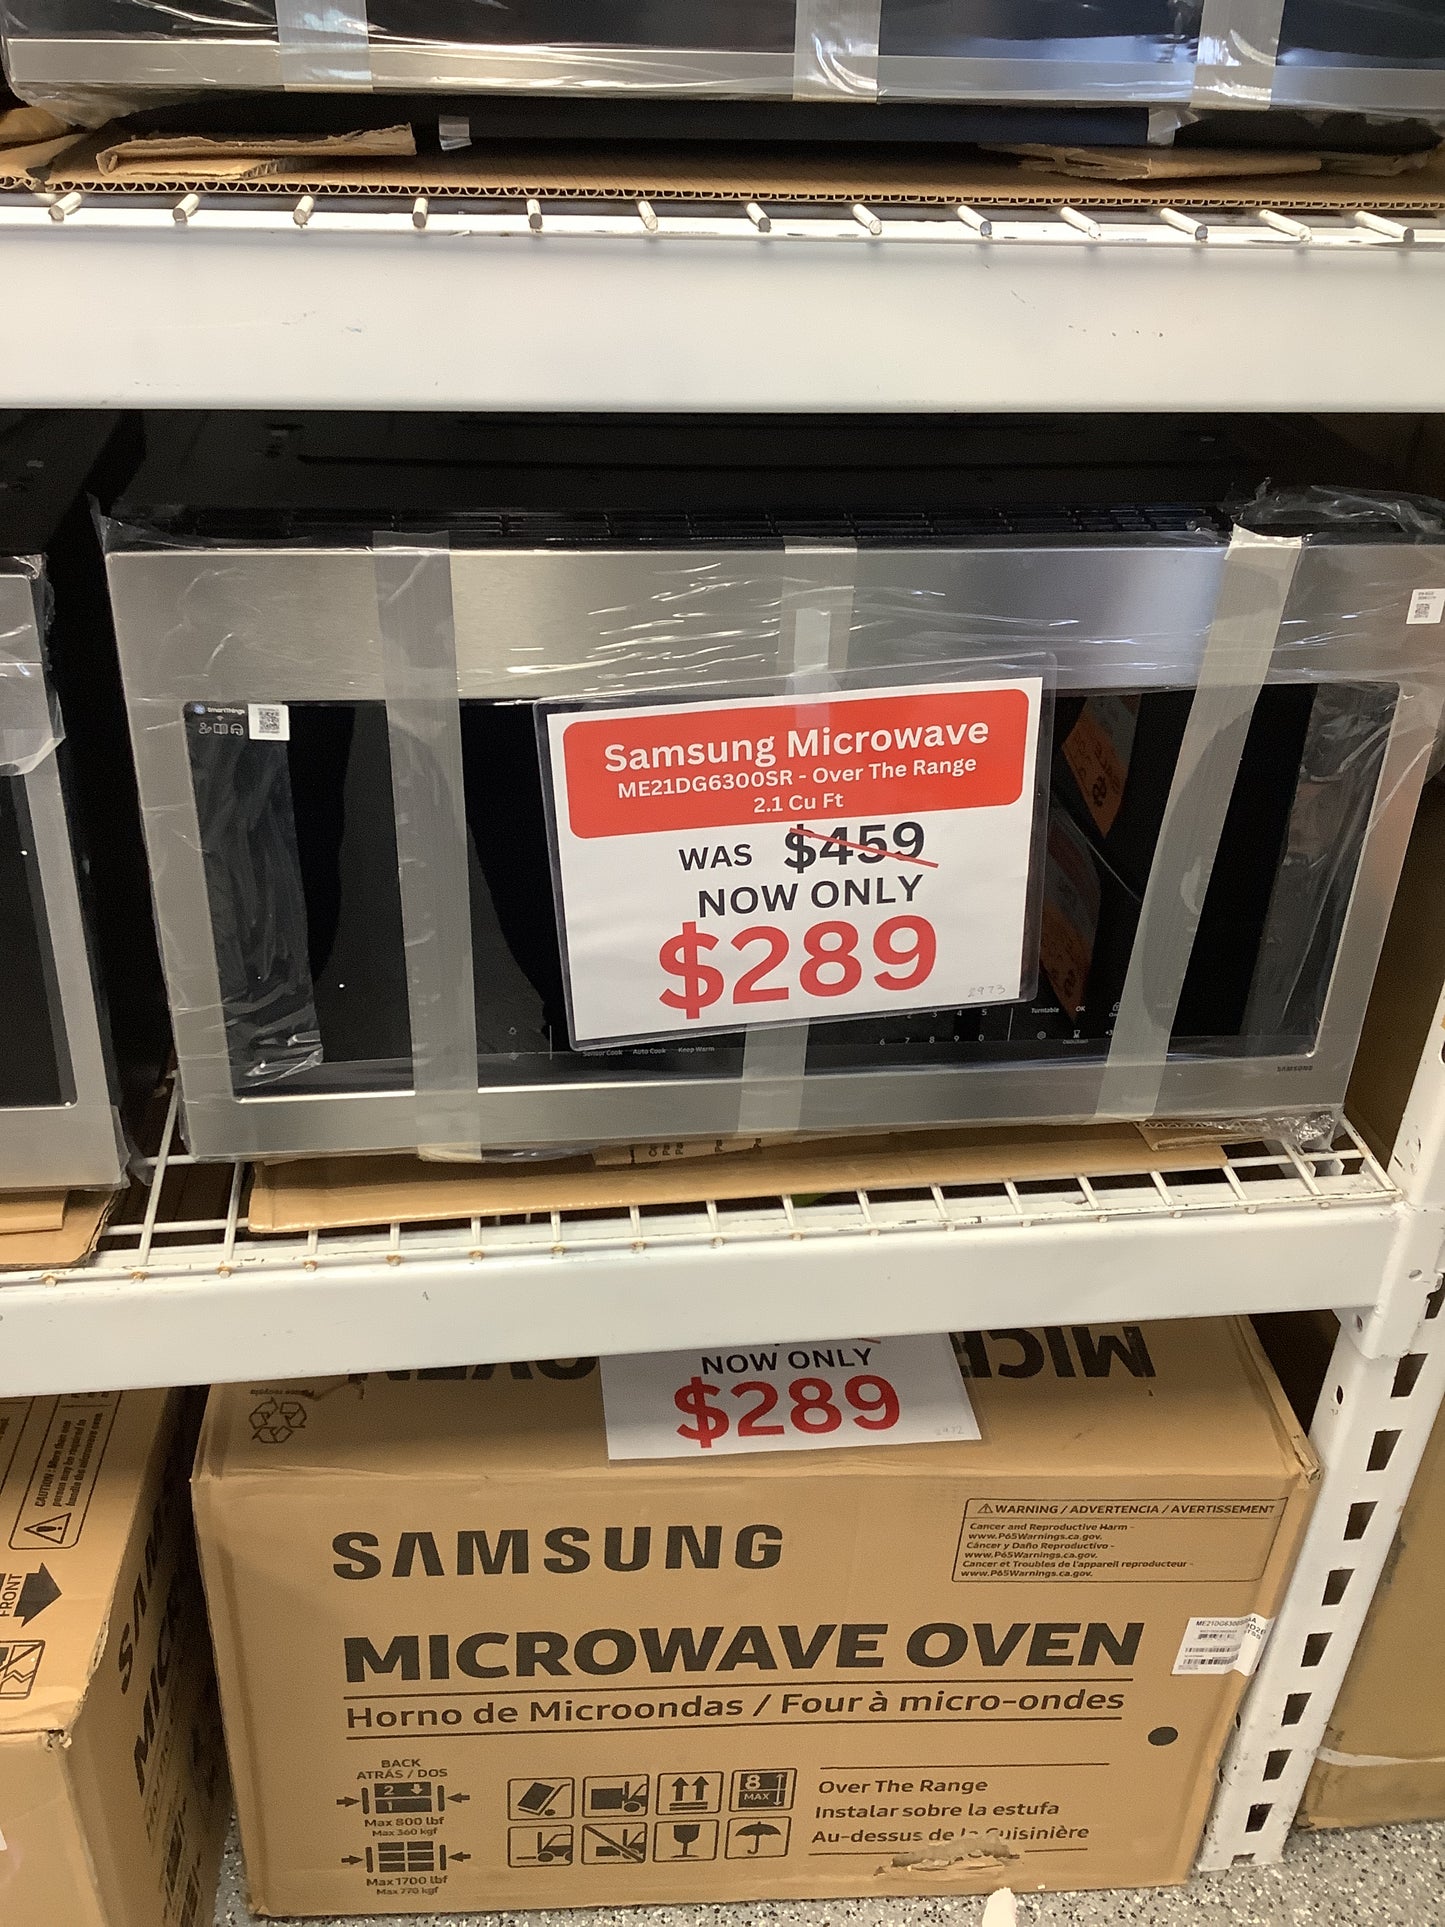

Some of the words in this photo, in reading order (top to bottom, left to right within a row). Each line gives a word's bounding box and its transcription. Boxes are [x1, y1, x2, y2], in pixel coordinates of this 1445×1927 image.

[604, 735, 777, 772] Samsung
[787, 721, 989, 758] Microwave
[618, 769, 793, 799] ME21DG6300SR
[813, 766, 864, 784] Over
[868, 762, 907, 780] The
[913, 758, 977, 777] Range
[753, 797, 783, 813] 2.1
[788, 795, 816, 811] Cu
[823, 793, 844, 808] Ft
[679, 844, 752, 871] WAS
[784, 821, 925, 874] $459
[699, 883, 799, 918] NOW
[811, 874, 923, 908] ONLY
[659, 914, 937, 1020] $289
[632, 1047, 649, 1055] Auto
[650, 1047, 666, 1055] Cook
[701, 1350, 779, 1375] NOW
[788, 1347, 873, 1369] ONLY
[674, 1374, 900, 1448] $289
[35, 1473, 54, 1507] CAUTION
[995, 1505, 1058, 1514] WARNING
[1069, 1505, 1159, 1514] ADVERTENCIA
[1171, 1504, 1275, 1514] AVERTISSEMENT
[970, 1523, 1005, 1531] Cancer
[1008, 1523, 1027, 1531] and
[1029, 1523, 1097, 1532] Reproductive
[1099, 1523, 1128, 1531] Harm
[968, 1533, 1103, 1541] www.P65Warnings.ca.gov.
[332, 1524, 783, 1580] SAMSUNG
[1004, 1543, 1010, 1551] y
[1012, 1541, 1038, 1549] Daño
[1040, 1542, 1109, 1551] Reproductivo
[964, 1551, 1098, 1559] www.P65Warnings.ca.gov.
[962, 1560, 997, 1568] Cancer
[1000, 1560, 1010, 1568] et
[1012, 1560, 1056, 1568] Troubles
[1058, 1560, 1070, 1568] de
[1073, 1560, 1119, 1569] l'appareil
[1121, 1561, 1187, 1569] reproducteur
[960, 1569, 1093, 1578] www.P65Warnings.ca.gov.
[344, 1624, 888, 1683] MICROWAVE
[906, 1622, 1144, 1667] OVEN
[347, 1706, 462, 1729] Horno
[473, 1702, 518, 1724] de
[530, 1695, 743, 1722] Microondas
[782, 1693, 862, 1714] Four
[868, 1690, 885, 1712] à
[900, 1689, 1124, 1713] micro-ondes
[381, 1759, 420, 1768] BACK
[357, 1769, 403, 1780] ATRÁS
[417, 1768, 448, 1778] DOS
[745, 1774, 760, 1790] 8
[818, 1781, 871, 1794] Over
[875, 1780, 914, 1793] The
[919, 1779, 988, 1795] Range
[384, 1785, 394, 1796] 2
[744, 1793, 770, 1801] MAX
[386, 1801, 393, 1811] 1
[815, 1805, 899, 1819] Instalar
[902, 1804, 962, 1818] sobre
[968, 1803, 987, 1816] la
[992, 1801, 1060, 1816] estufa
[364, 1819, 393, 1827] Max
[395, 1818, 423, 1826] 800
[426, 1816, 445, 1825] lbf
[372, 1829, 396, 1837] Max
[420, 1827, 438, 1837] kgf
[811, 1829, 923, 1844] Au-dessus
[928, 1828, 955, 1842] de
[366, 1878, 394, 1887] Max
[395, 1876, 427, 1885] 1700
[430, 1875, 448, 1884] lbf
[376, 1888, 398, 1896] Max
[422, 1886, 439, 1895] kgf
